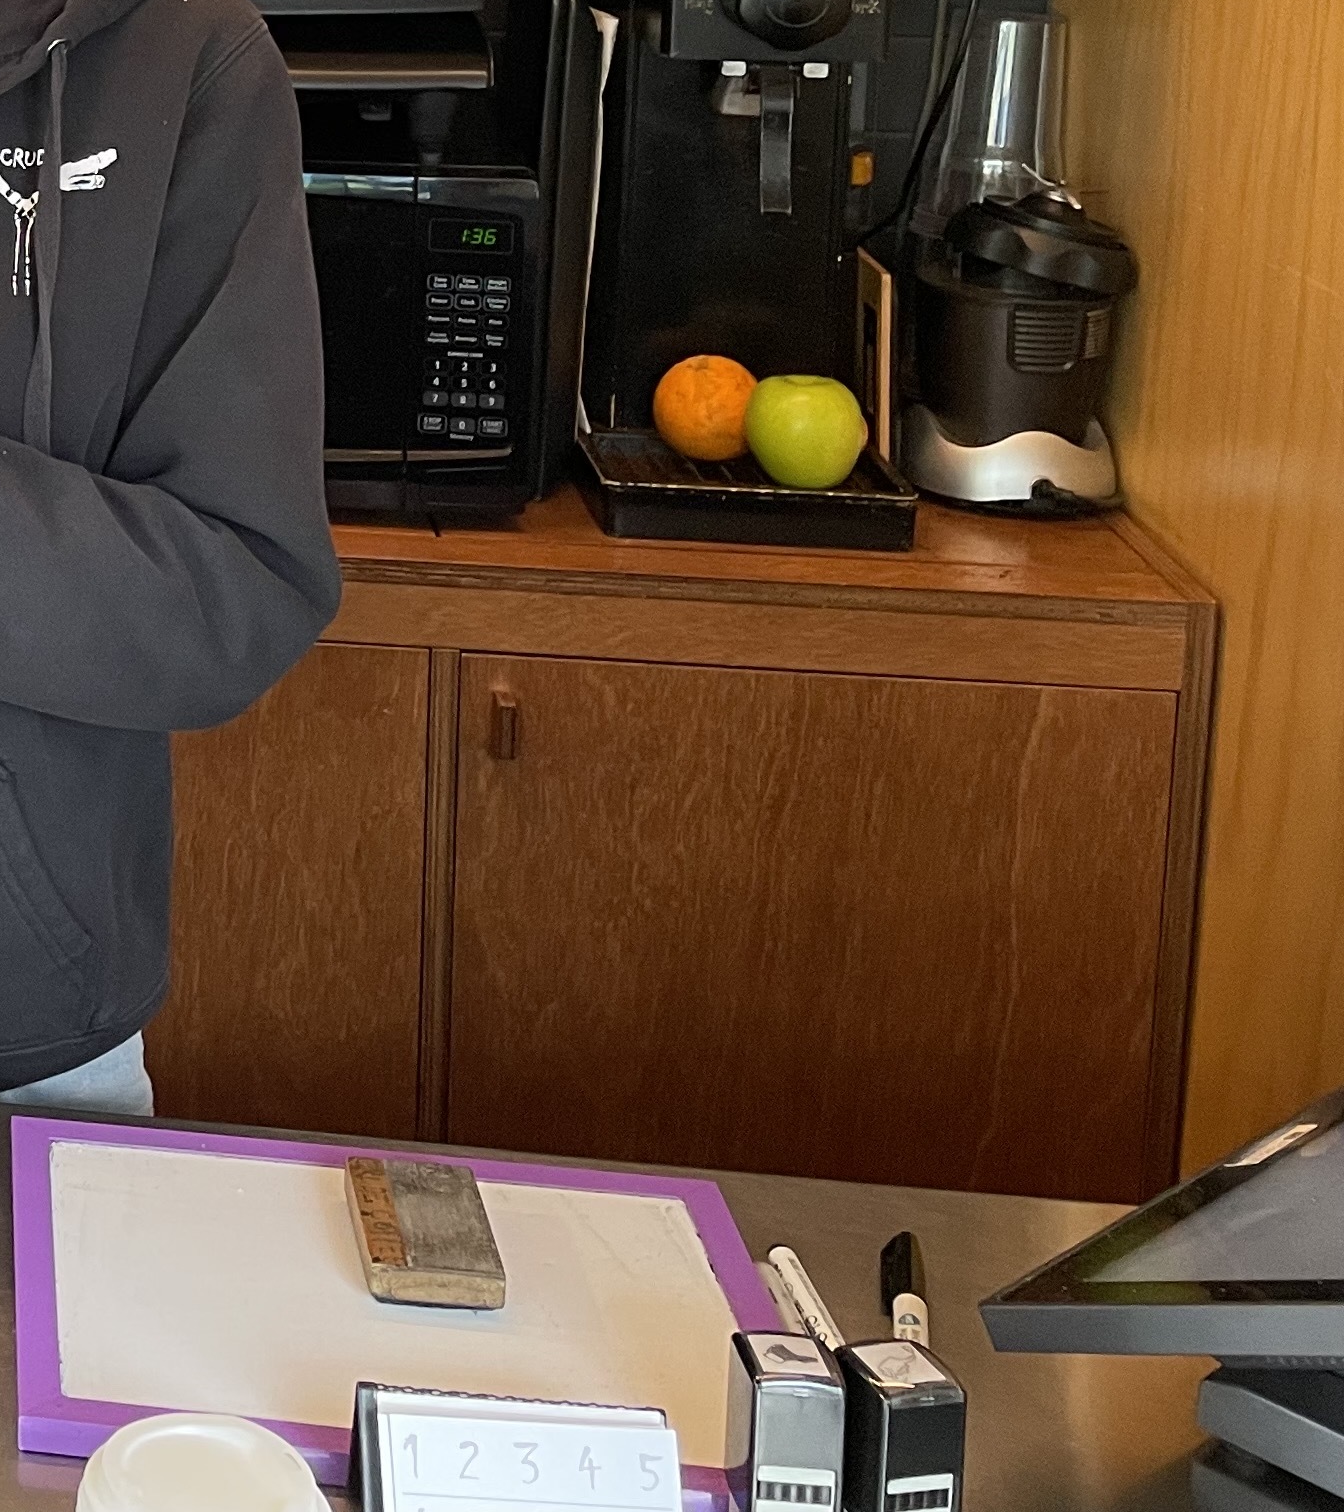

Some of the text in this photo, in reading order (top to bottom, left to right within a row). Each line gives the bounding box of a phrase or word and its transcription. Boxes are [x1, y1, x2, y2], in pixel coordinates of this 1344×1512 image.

[402, 1433, 665, 1493] 1 2 3 4 5
